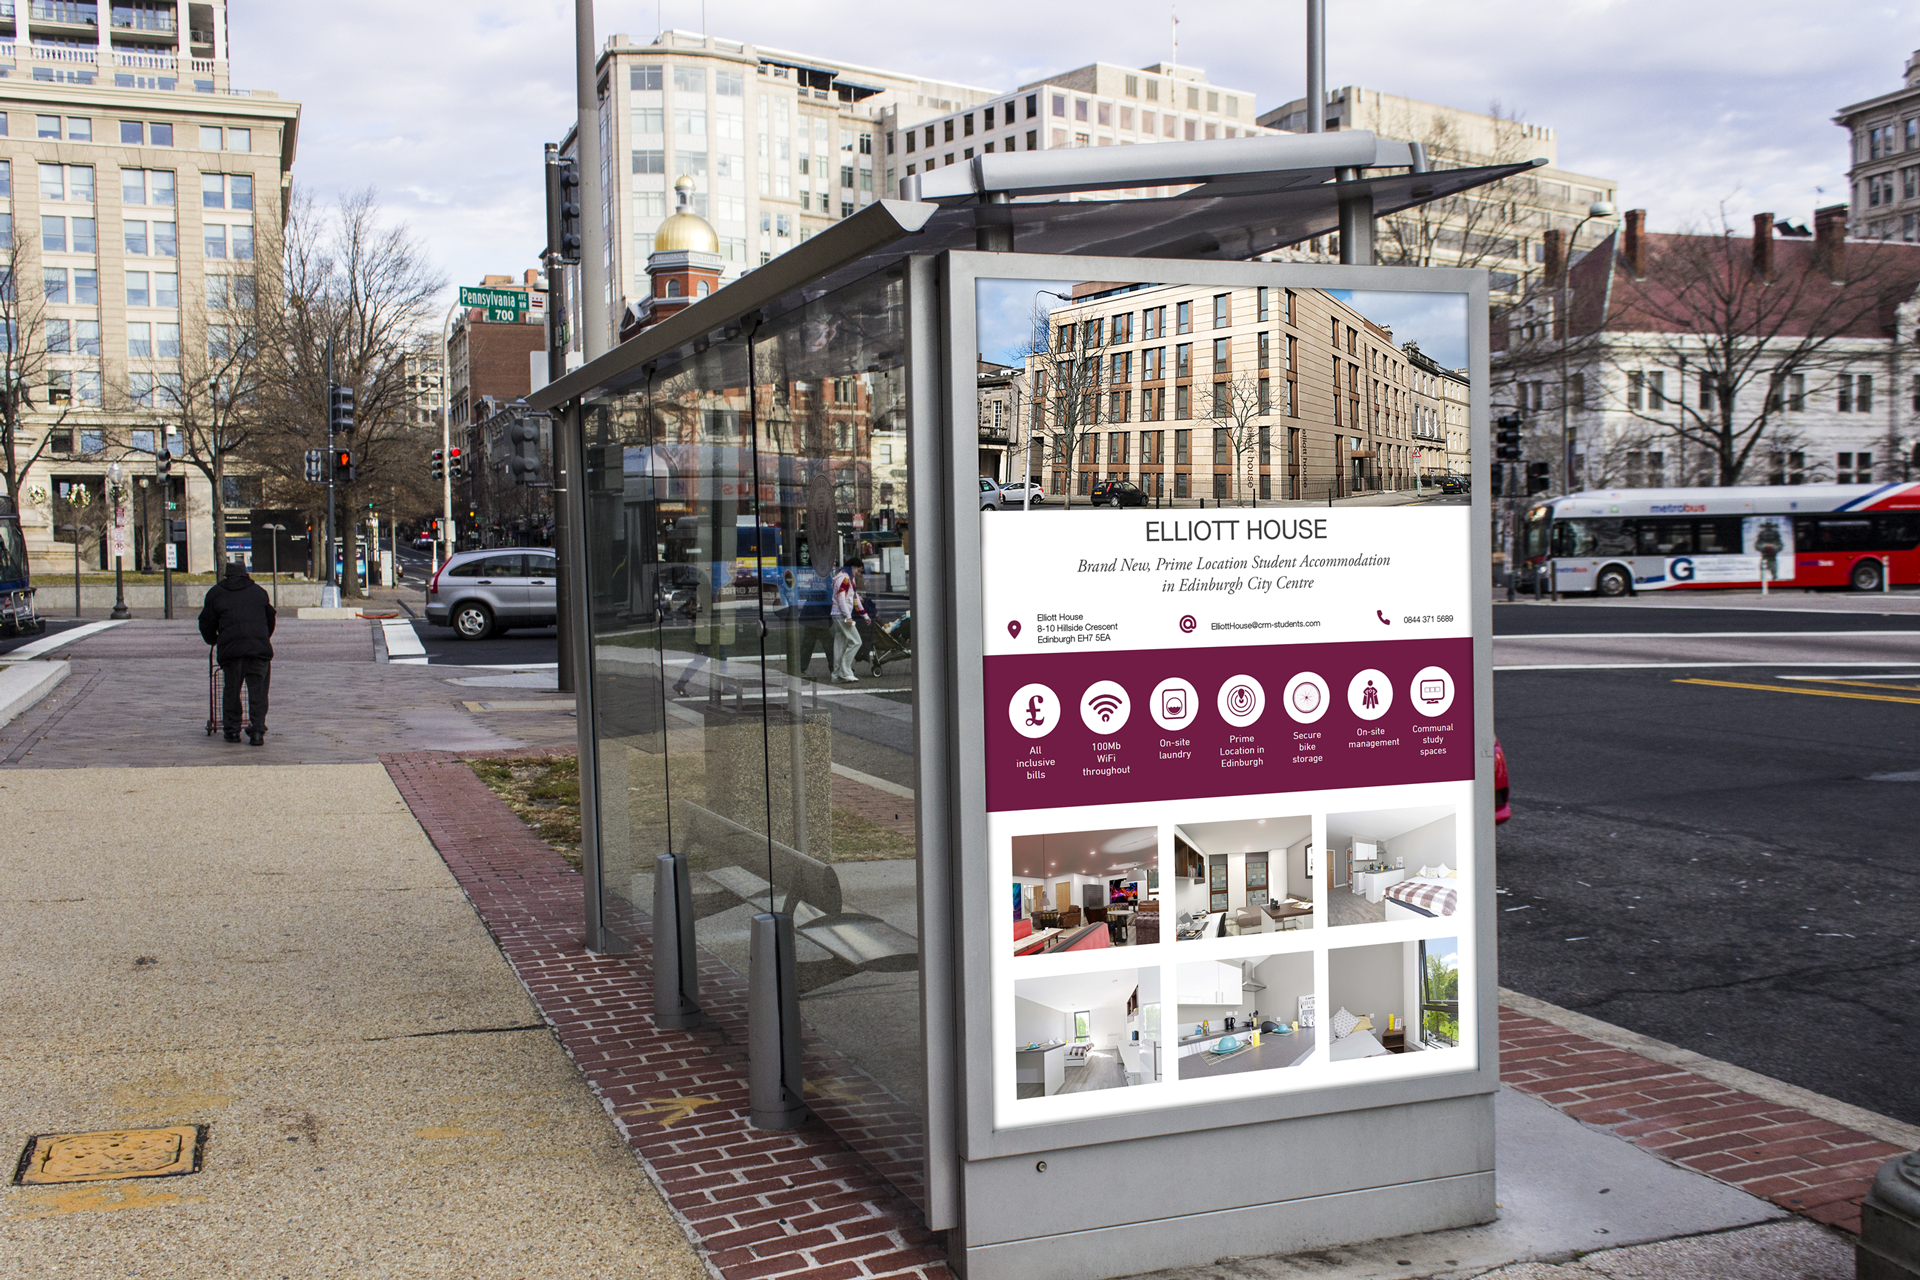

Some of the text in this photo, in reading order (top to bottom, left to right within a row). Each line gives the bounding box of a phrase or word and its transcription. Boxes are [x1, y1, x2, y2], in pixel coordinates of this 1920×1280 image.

[461, 288, 527, 308] Pennsylvania AVE
[495, 309, 514, 321] 700
[1650, 503, 1706, 513] metrobus
[1146, 519, 1327, 541] ELLIOTT HOUSE
[1077, 553, 1390, 572] Brand New, Prime Location Student Accommodation
[1670, 557, 1694, 581] G
[1162, 576, 1314, 595] in Edinburgh City Centre
[1037, 613, 1084, 622] Elliott House
[1403, 614, 1454, 624] 0844 371 5689
[1036, 622, 1118, 633] 8-10 Hillside Crescent
[1210, 620, 1321, 631] ElliottHouse@crm-students.com
[1037, 633, 1111, 645] Edinburgh EH7 5EA
[1356, 726, 1386, 737] On-site
[1412, 722, 1454, 734] Communal
[1229, 734, 1255, 744] Prime
[1292, 731, 1322, 740] Secure
[1422, 735, 1444, 745] study
[1091, 741, 1122, 752] 100Mb
[1159, 737, 1191, 748] On-site
[1298, 742, 1317, 752] bike
[1348, 737, 1400, 749] management
[1029, 745, 1042, 755] All
[1158, 749, 1192, 760] laundry
[1220, 745, 1265, 755] Location in
[1419, 747, 1447, 757] spaces
[1016, 757, 1056, 768] inclusive
[1096, 753, 1116, 763] WiFi
[1221, 757, 1264, 768] Edinburgh
[1292, 755, 1324, 764] storage
[1026, 770, 1046, 780] bills
[1082, 765, 1131, 777] throughout
